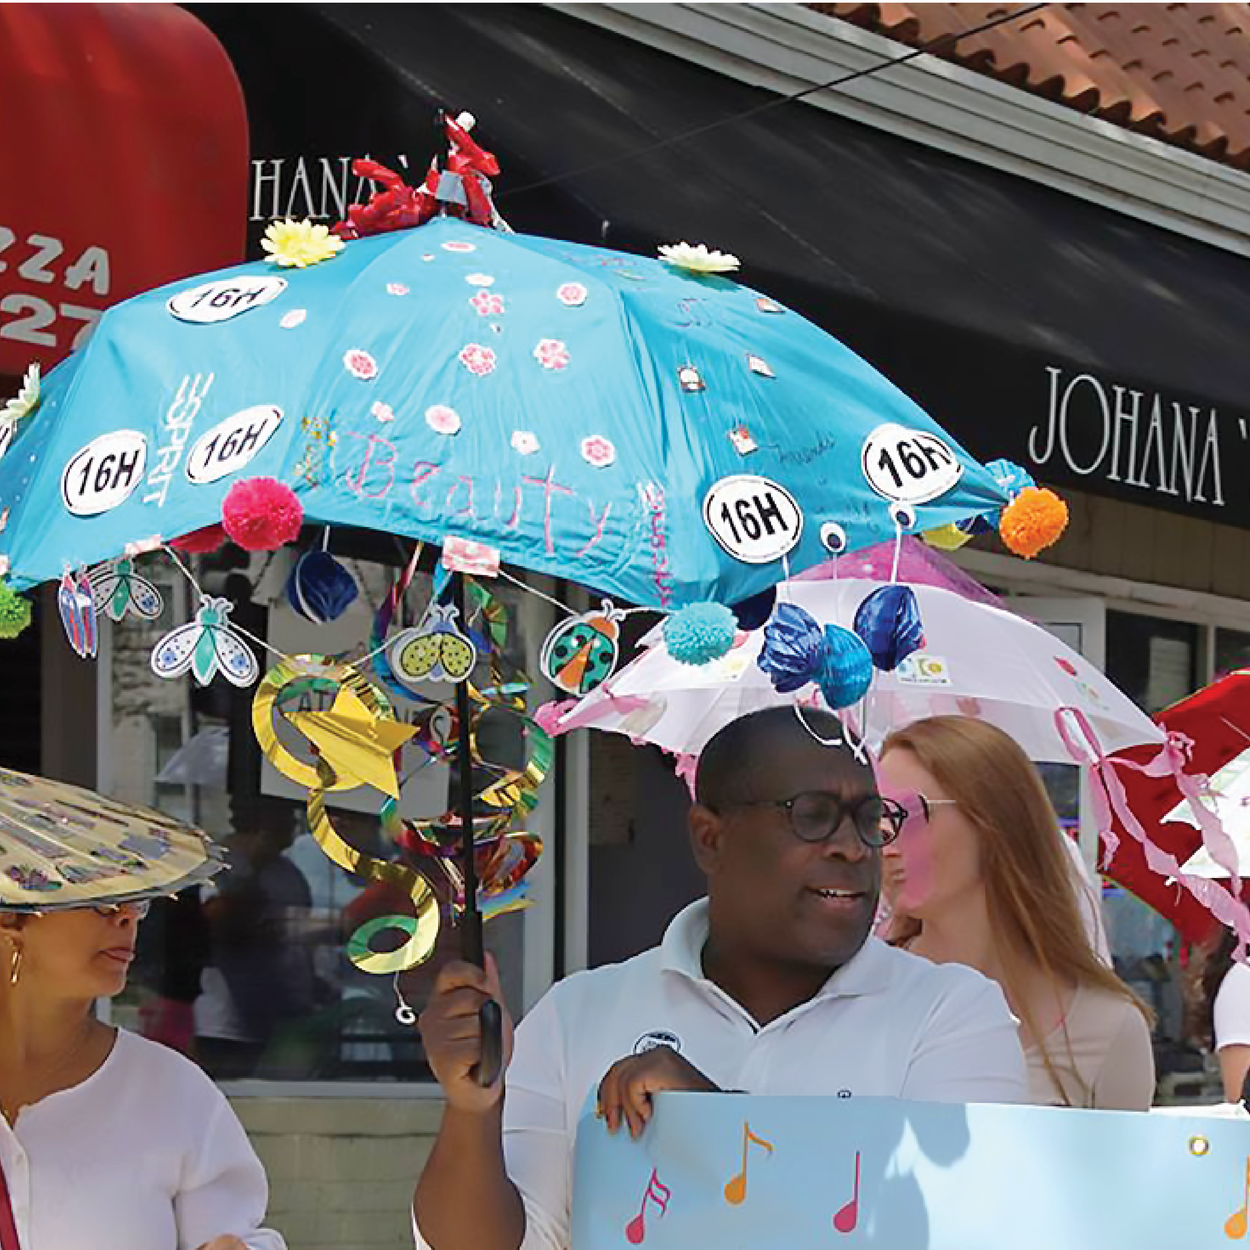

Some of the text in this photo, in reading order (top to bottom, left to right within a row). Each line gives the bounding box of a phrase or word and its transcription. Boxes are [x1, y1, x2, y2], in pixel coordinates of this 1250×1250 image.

[191, 286, 266, 308] 16H
[203, 418, 269, 470] 16H
[78, 448, 141, 496] 16H
[720, 492, 790, 544] 16H
